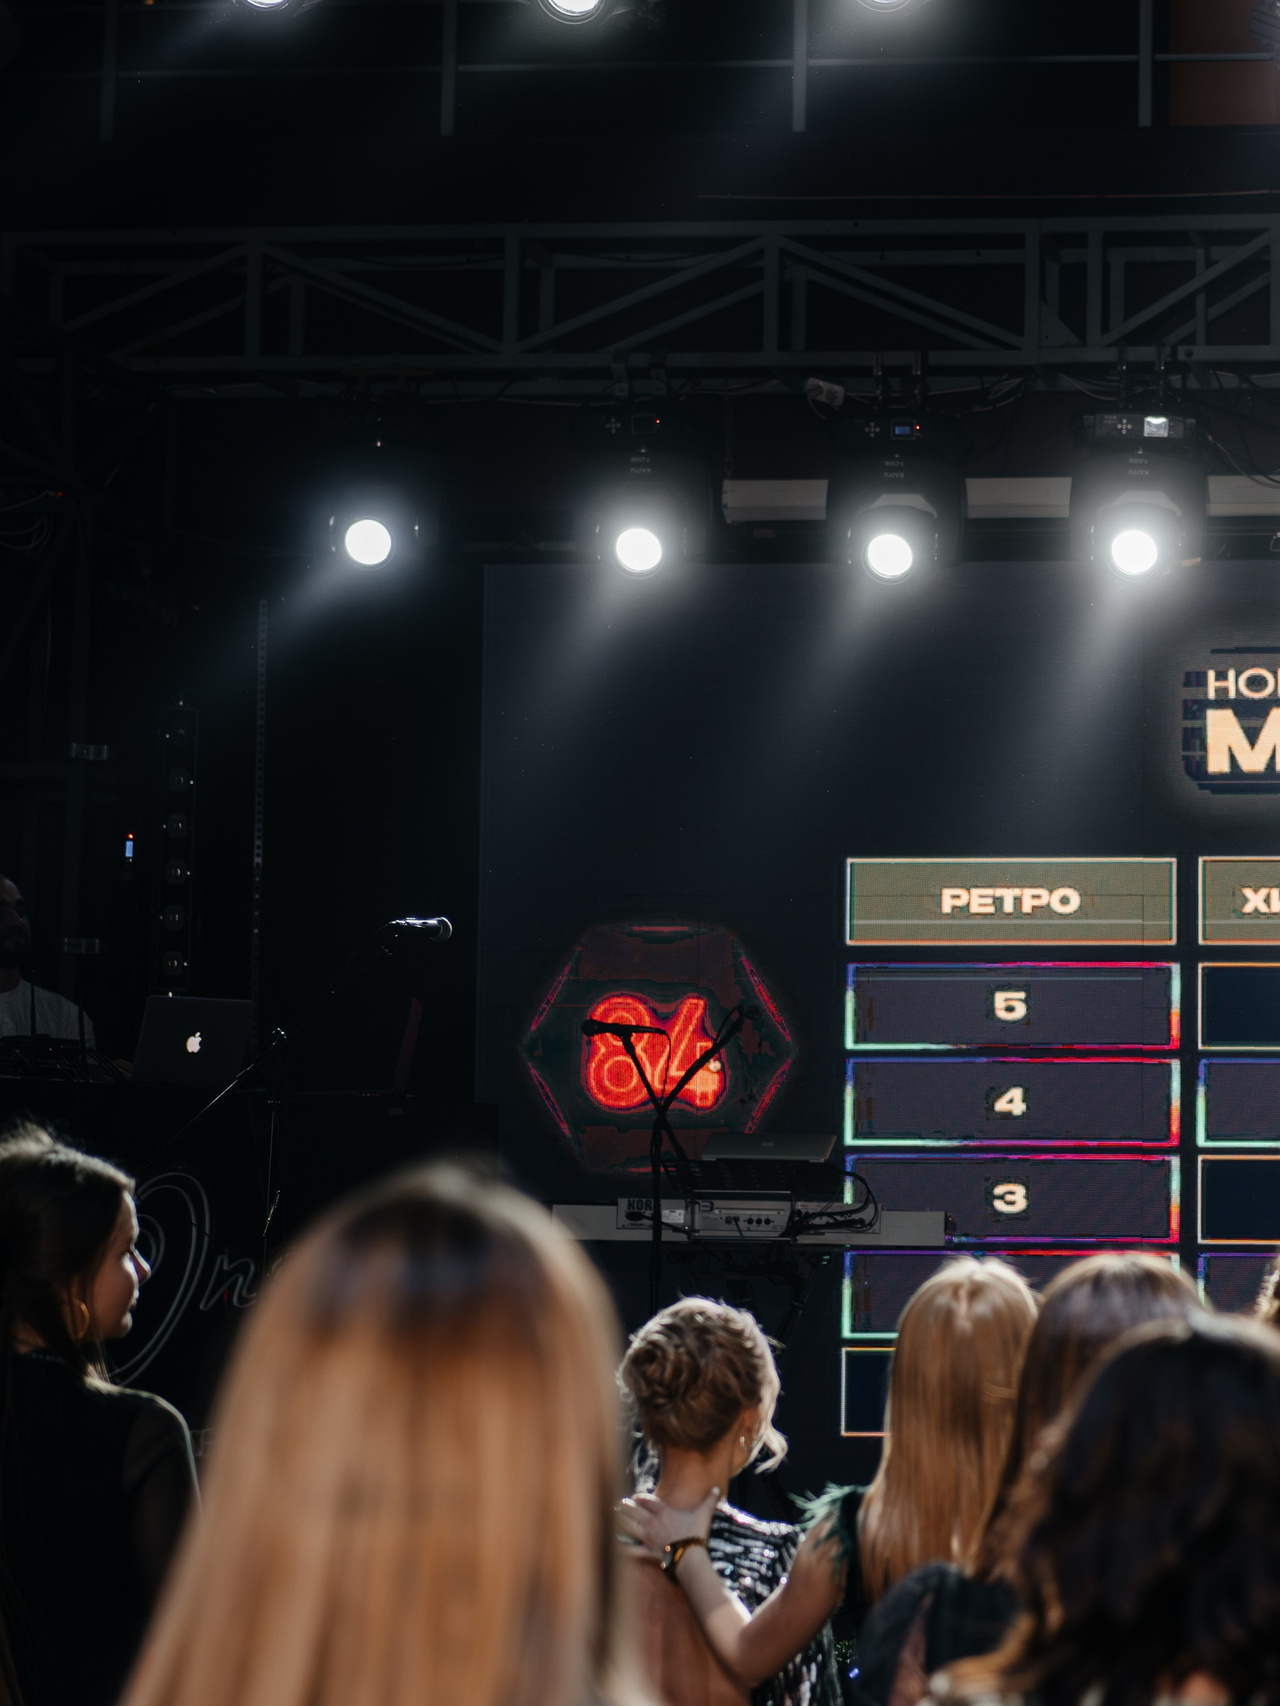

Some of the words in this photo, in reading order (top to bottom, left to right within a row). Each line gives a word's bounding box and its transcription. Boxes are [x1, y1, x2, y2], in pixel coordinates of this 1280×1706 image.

[940, 887, 1082, 915] РЕТРО
[993, 990, 1028, 1022] 5
[993, 1087, 1028, 1117] 4
[992, 1183, 1029, 1215] 3
